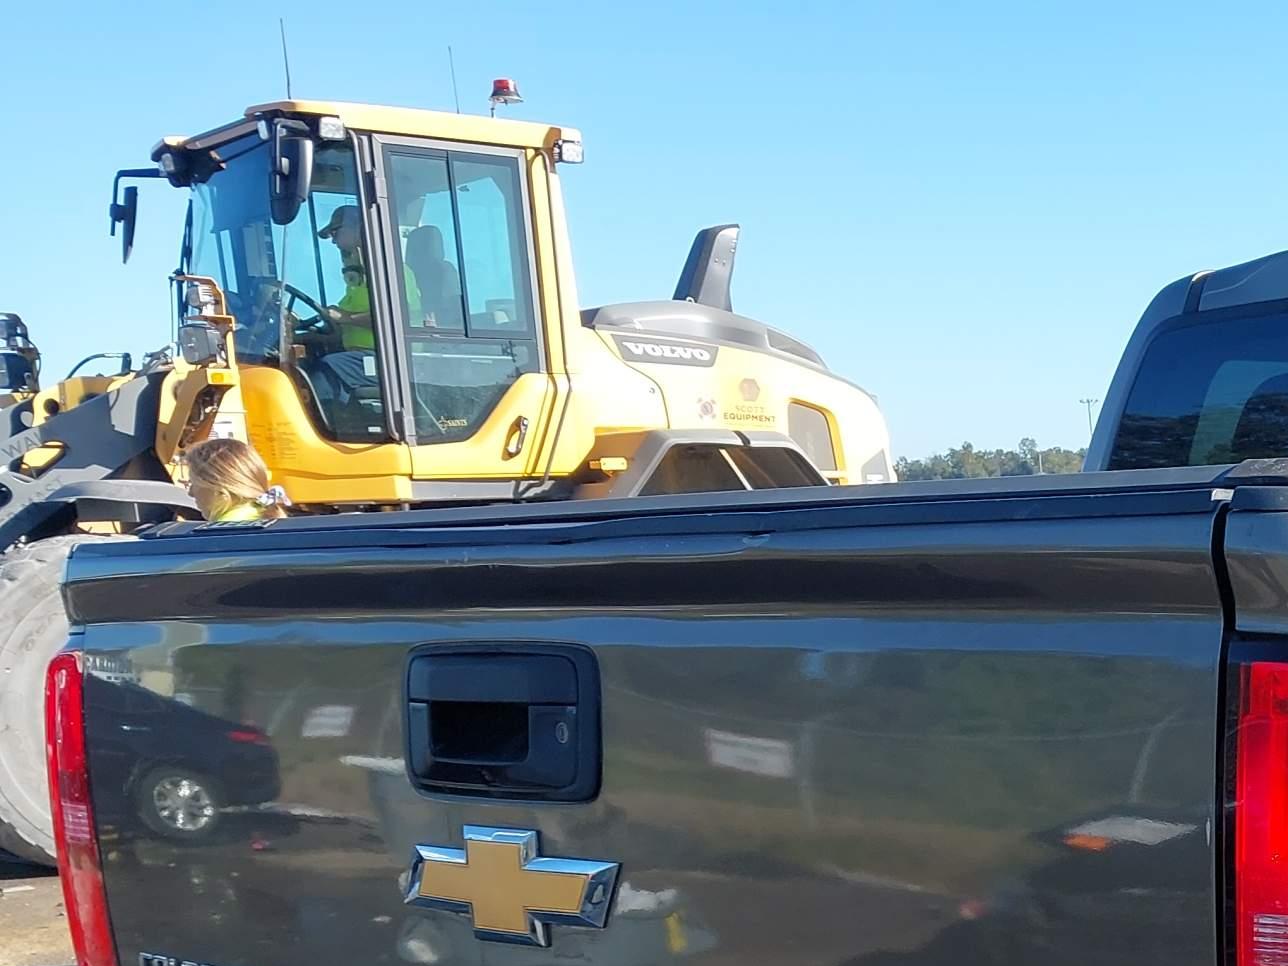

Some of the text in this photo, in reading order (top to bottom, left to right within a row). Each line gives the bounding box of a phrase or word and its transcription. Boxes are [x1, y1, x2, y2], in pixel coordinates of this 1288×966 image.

[622, 341, 711, 361] VOLVO
[735, 405, 765, 414] SCOTT
[723, 412, 775, 423] EQUIPMENT
